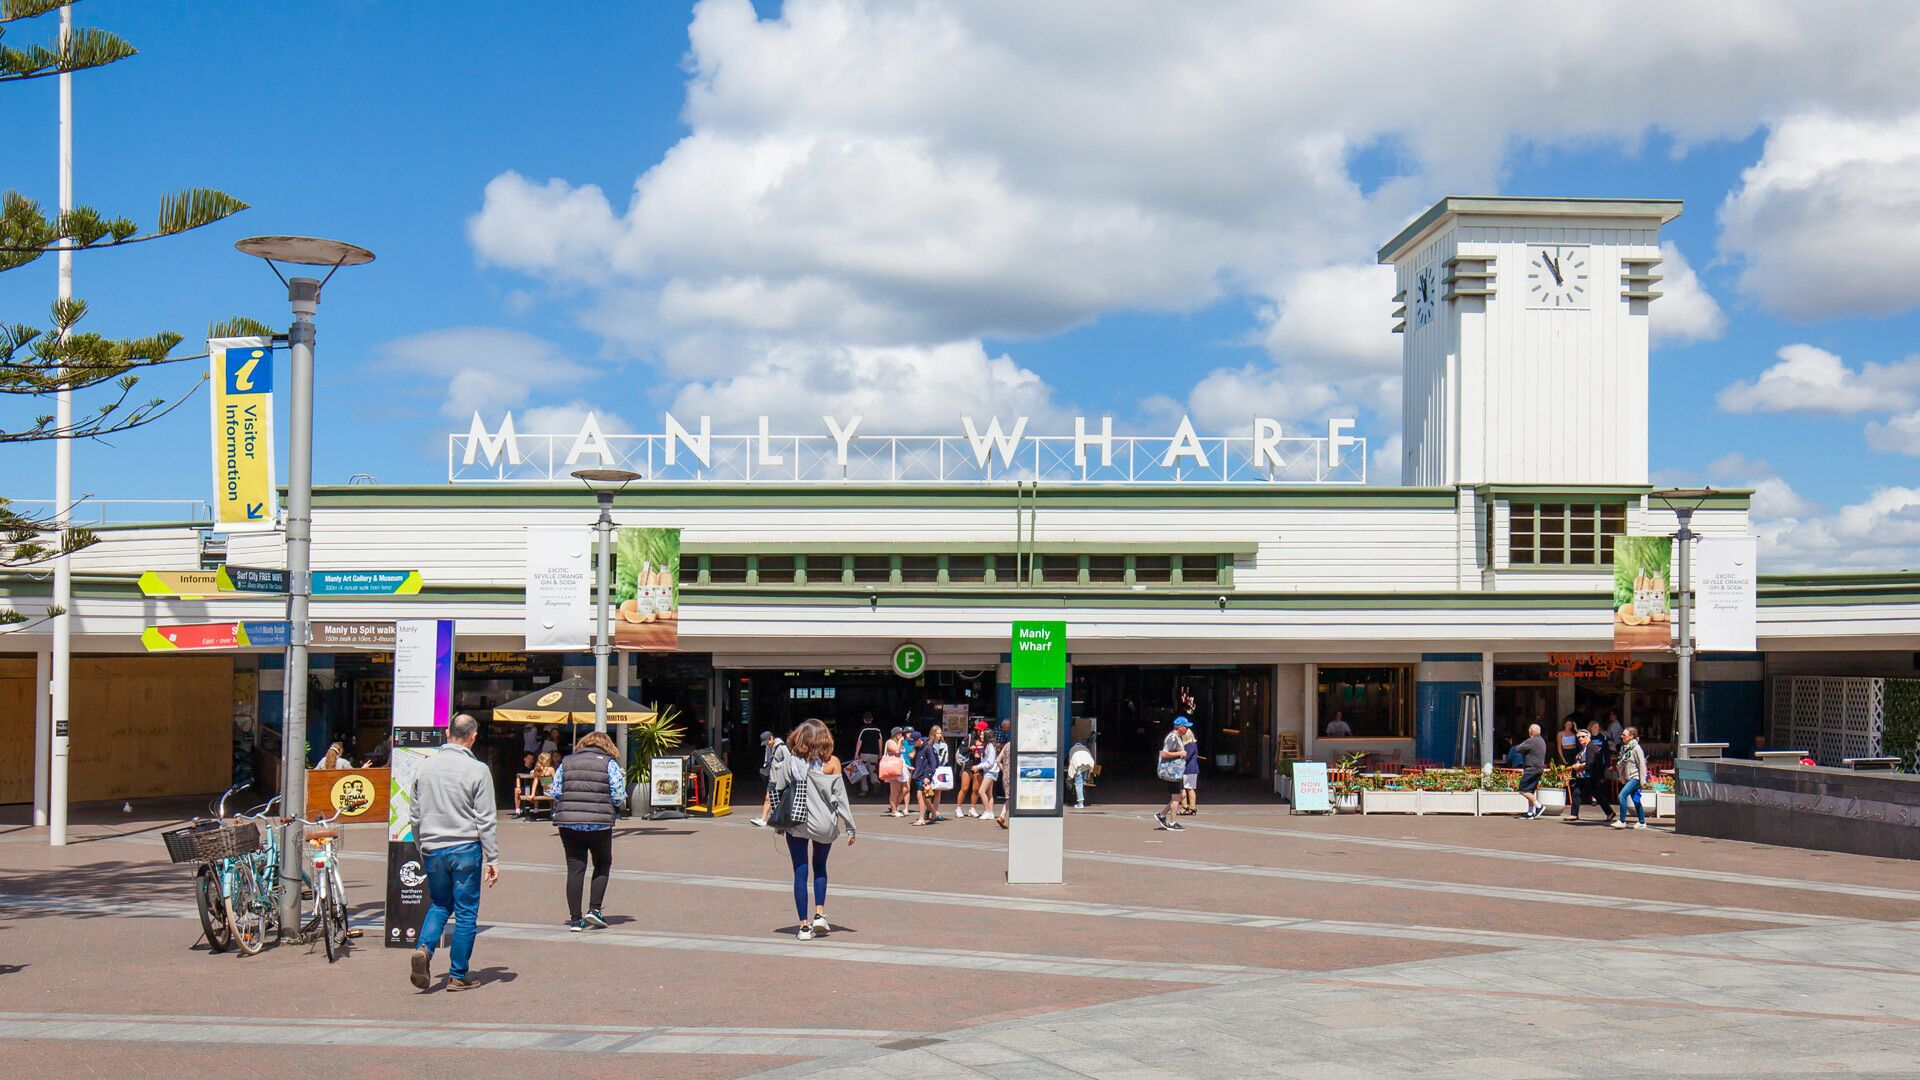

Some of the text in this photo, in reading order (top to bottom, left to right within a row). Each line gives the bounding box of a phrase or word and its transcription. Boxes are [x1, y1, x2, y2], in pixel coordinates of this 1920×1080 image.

[243, 404, 258, 460] Visitor
[462, 410, 1355, 470] MANLY WHARF
[225, 404, 241, 501] Information
[236, 570, 249, 580] Surf
[248, 571, 259, 582] City
[259, 572, 271, 581] FREE
[324, 575, 342, 583] Manly
[352, 575, 372, 583] Gallery
[379, 574, 404, 582] Museum
[324, 625, 396, 635] Manly to Spit walk
[1019, 628, 1051, 640] Manly
[202, 637, 215, 645] East
[1019, 641, 1052, 651] Wharf
[905, 651, 915, 669] F
